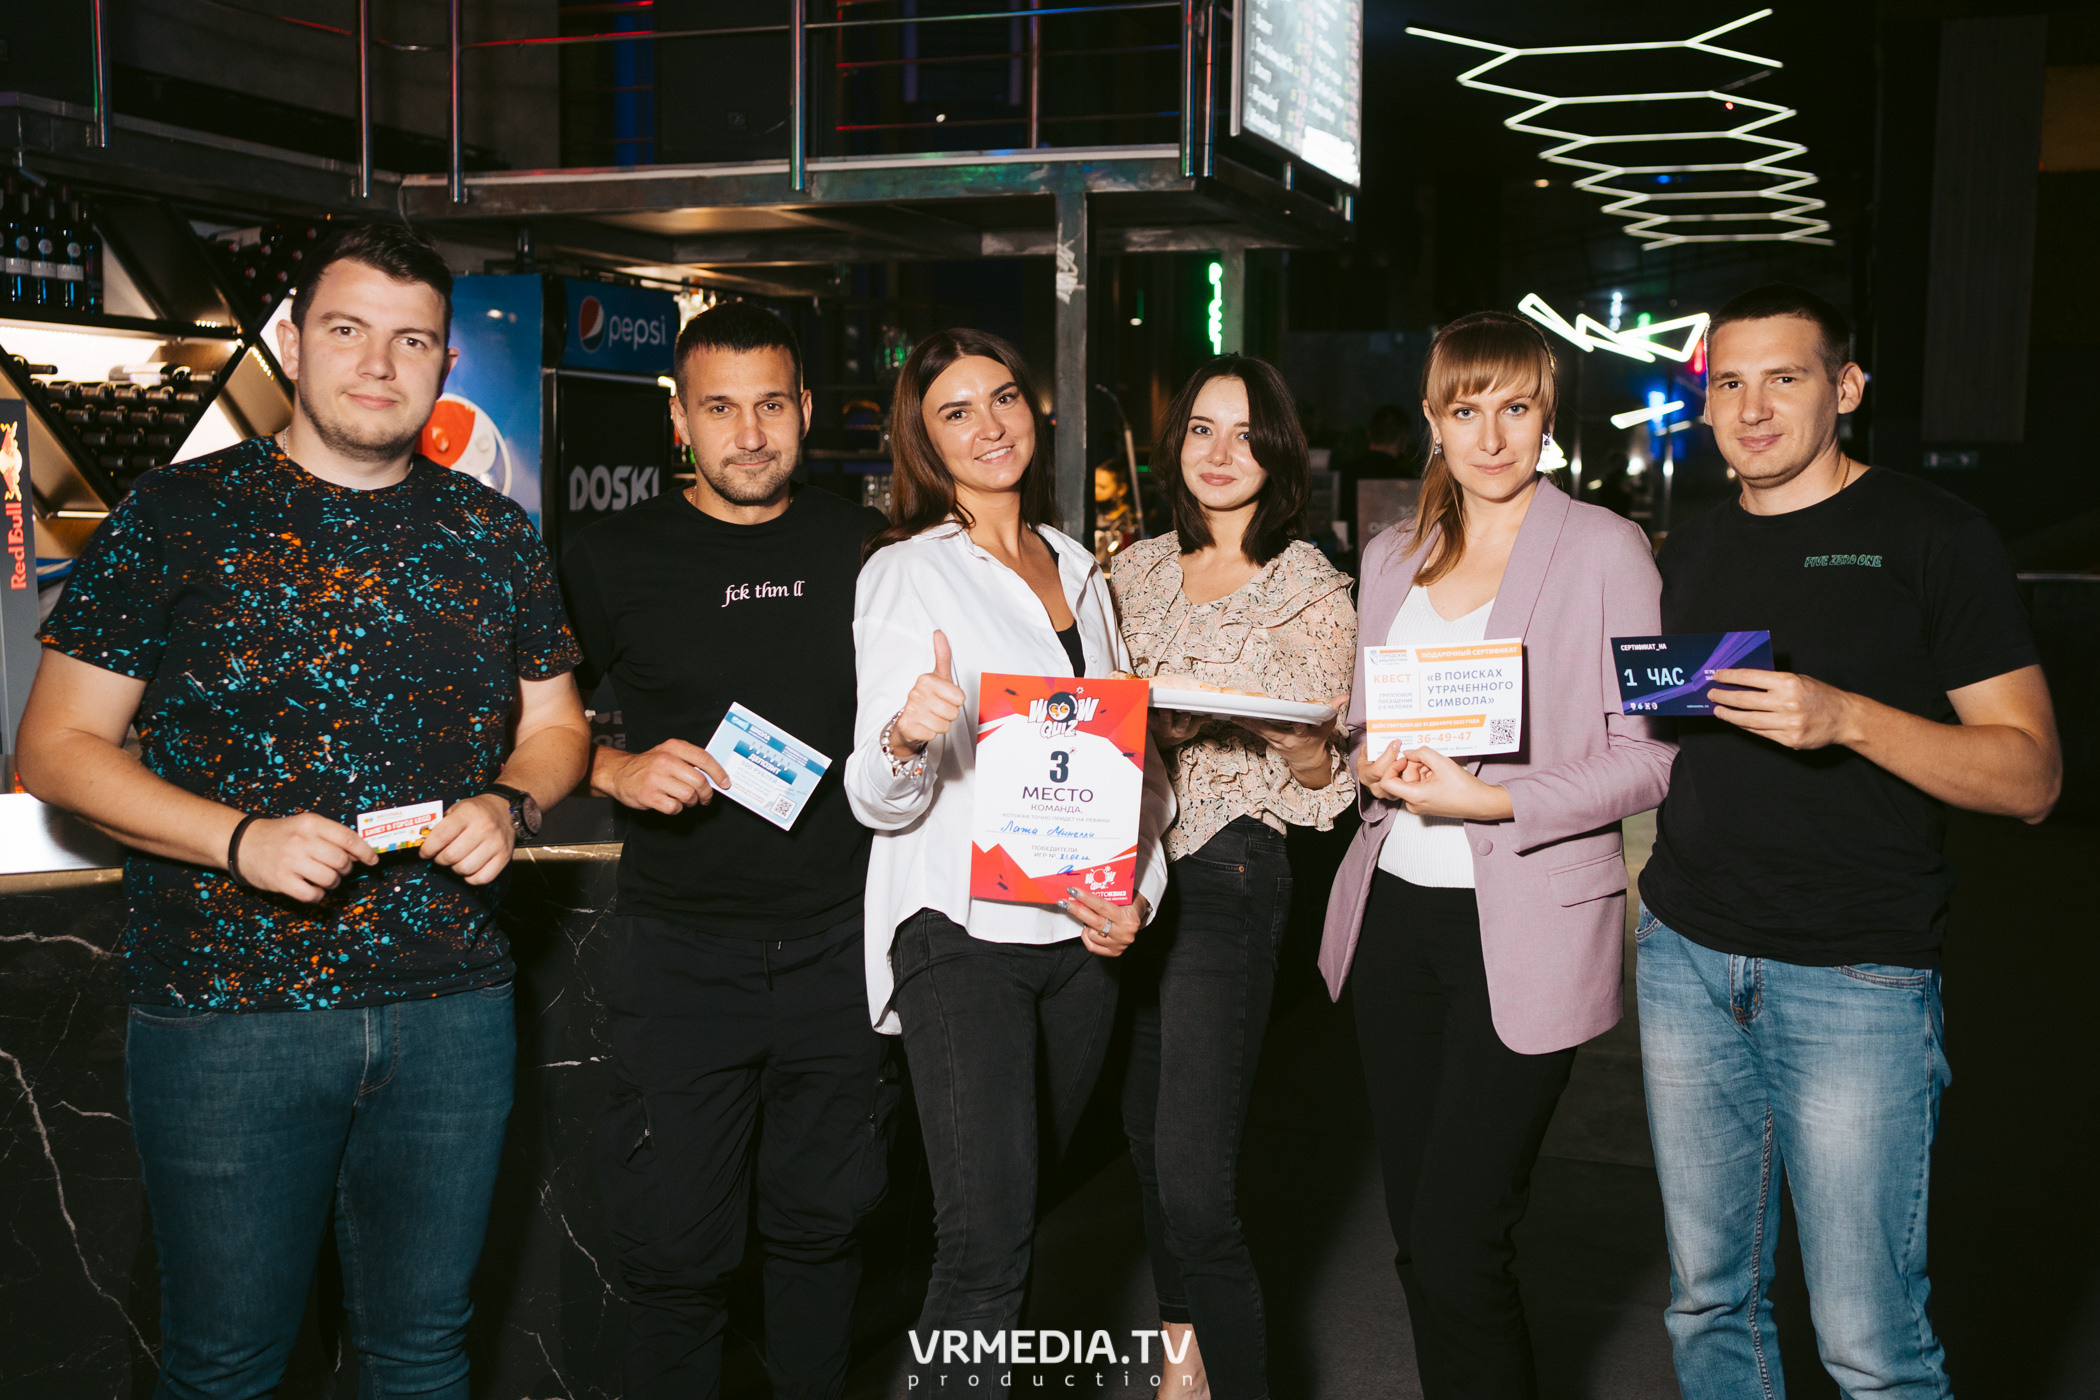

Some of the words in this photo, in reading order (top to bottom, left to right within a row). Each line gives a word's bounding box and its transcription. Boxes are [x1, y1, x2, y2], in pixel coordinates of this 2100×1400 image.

[609, 315, 667, 350] pepsi
[1804, 555, 1829, 568] FIVE
[1829, 553, 1857, 566] ZERO
[1857, 553, 1883, 568] ONE
[721, 583, 751, 608] fck
[754, 581, 790, 599] thm
[1472, 646, 1518, 656] СЕРТИФИКАТ
[1374, 673, 1412, 684] КВЕСТ
[1445, 669, 1503, 680] ПОИСКАХ
[1624, 668, 1638, 687] 1
[1646, 667, 1685, 686] ЧАС
[1427, 681, 1513, 694] УТРАЧЕННОГО
[1427, 696, 1495, 708] СИМВОЛА»
[1040, 720, 1079, 739] QUIZ
[1417, 731, 1472, 744] 36-49-47
[748, 753, 781, 775] ДЕПОЗИТ
[1049, 750, 1069, 783] 3
[1022, 786, 1094, 803] МЕСТО
[1031, 845, 1078, 853] ПОБЕДИТЕЛИ
